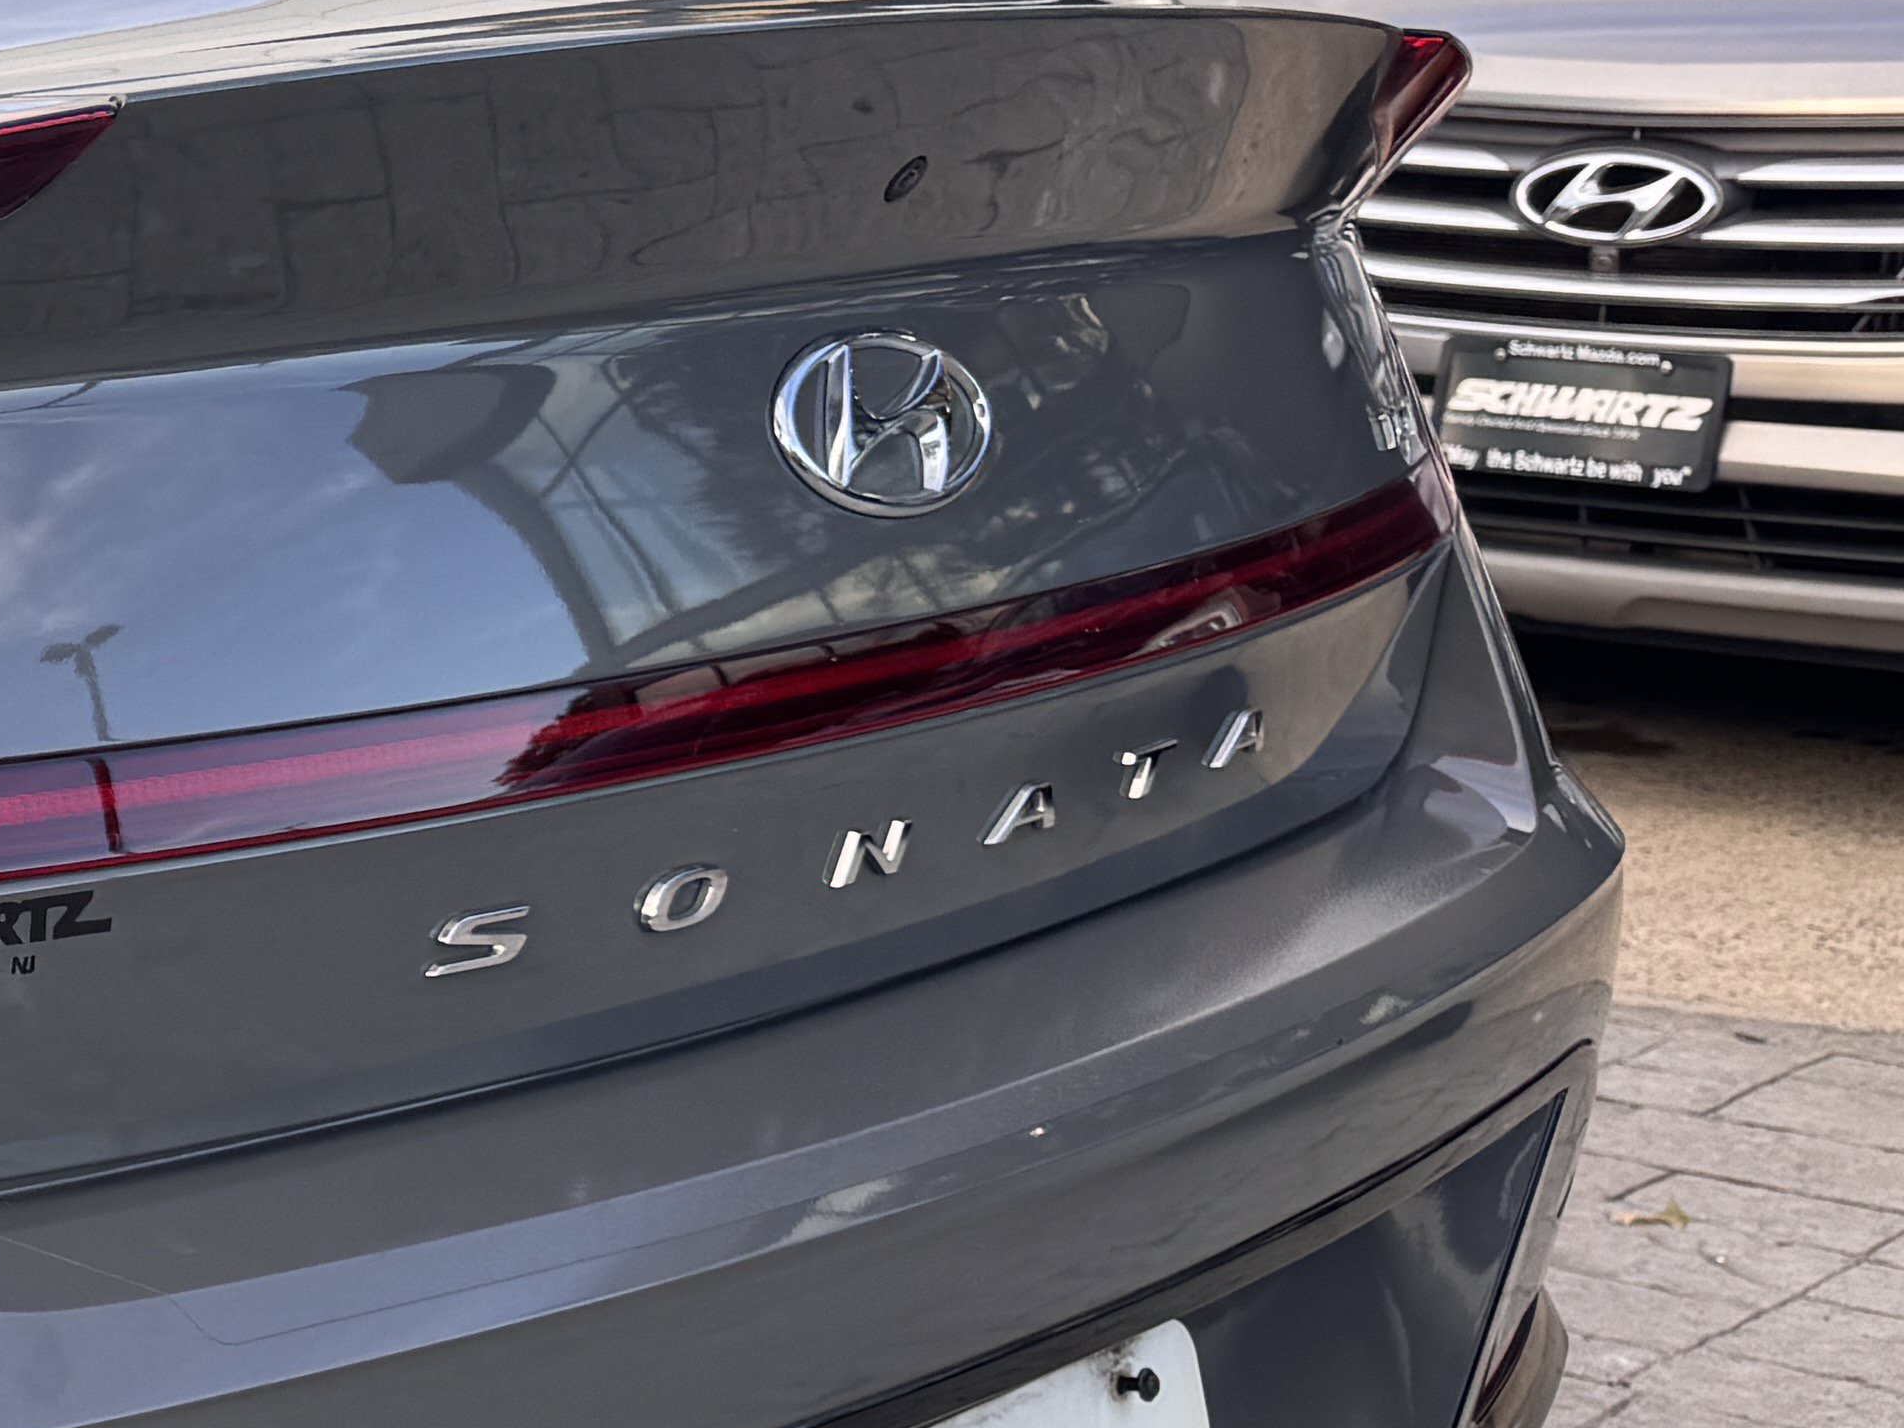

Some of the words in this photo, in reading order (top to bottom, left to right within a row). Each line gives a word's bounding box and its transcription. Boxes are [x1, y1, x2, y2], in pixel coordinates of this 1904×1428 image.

[1446, 377, 1714, 432] SCHWARTZ
[1486, 447, 1511, 469] the
[1514, 449, 1585, 477] Schwartz
[1586, 456, 1607, 479] be
[1609, 459, 1643, 483] with
[423, 707, 1266, 979] SONATA
[11, 954, 36, 975] NJ
